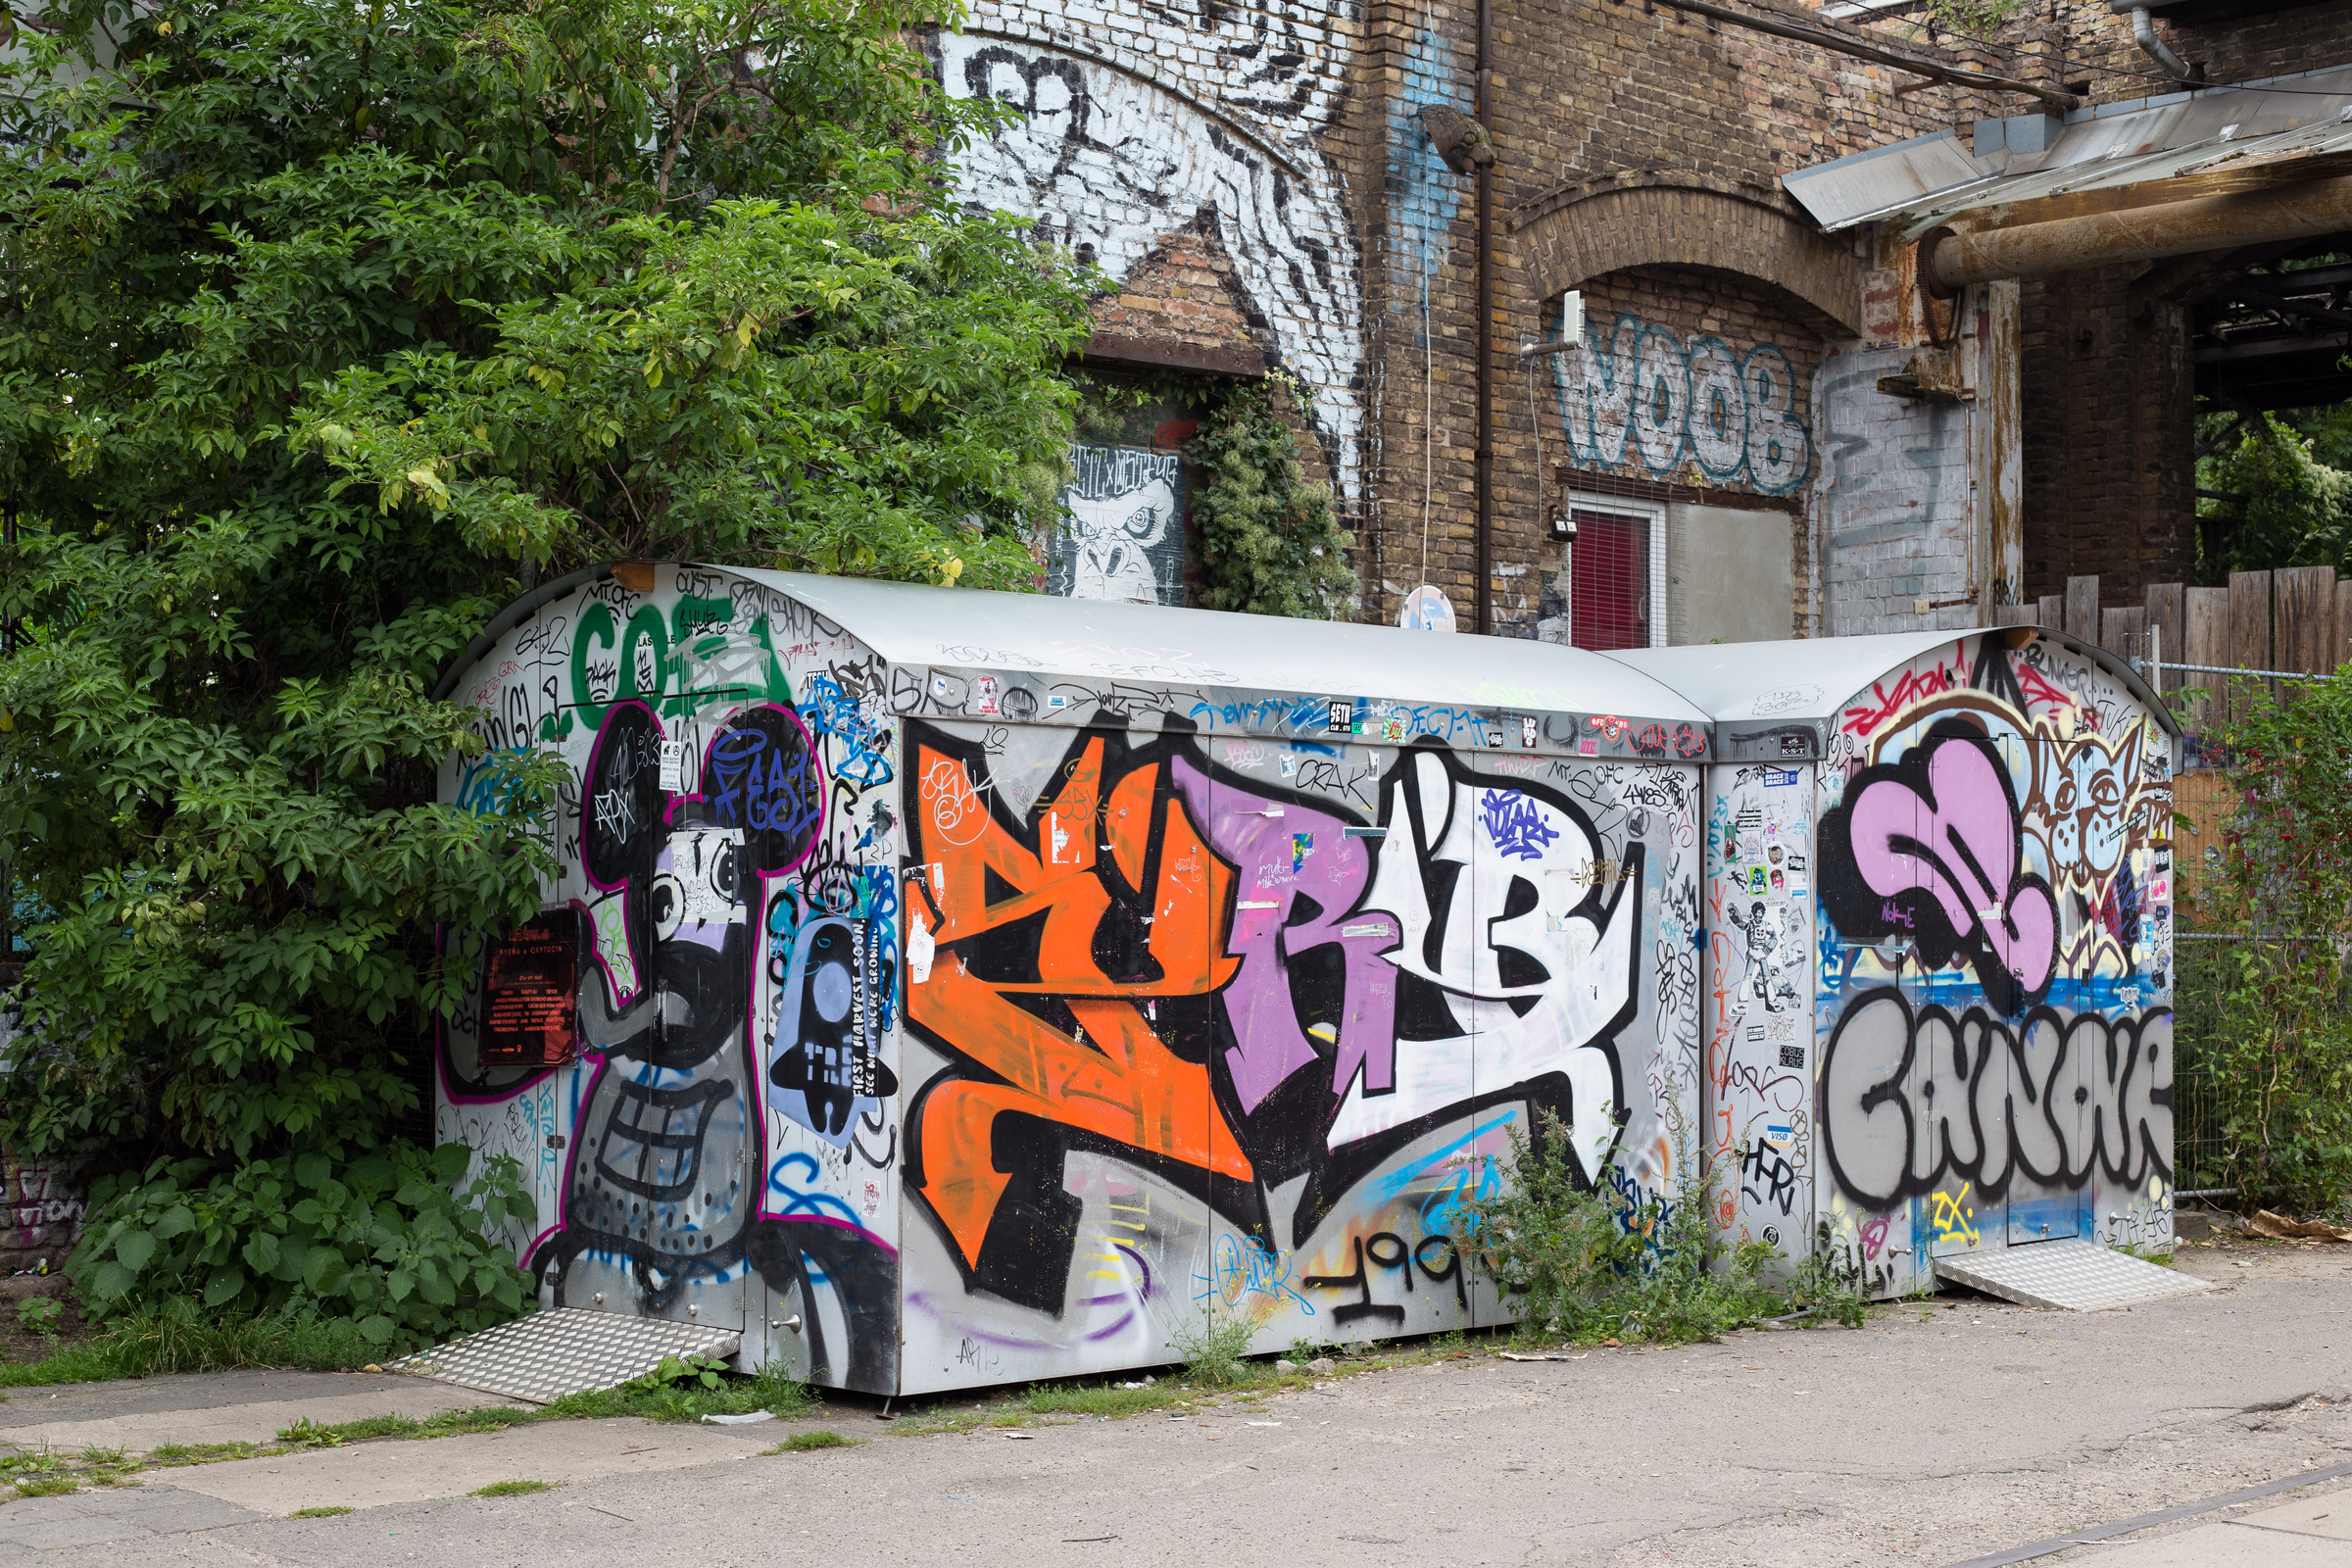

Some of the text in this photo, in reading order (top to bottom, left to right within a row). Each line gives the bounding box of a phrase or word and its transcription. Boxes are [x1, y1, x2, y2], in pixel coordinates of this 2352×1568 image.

[1330, 703, 1351, 724] SETH
[1296, 760, 1373, 810] ORAK
[530, 945, 563, 955] OXYTOCIN
[853, 975, 864, 1047] HARVEST
[867, 990, 879, 1028] WE'RE
[866, 1032, 877, 1069] WHAT
[1779, 1056, 1804, 1069] KLAUS
[853, 1055, 864, 1098] FIRST
[865, 1070, 875, 1096] SEE
